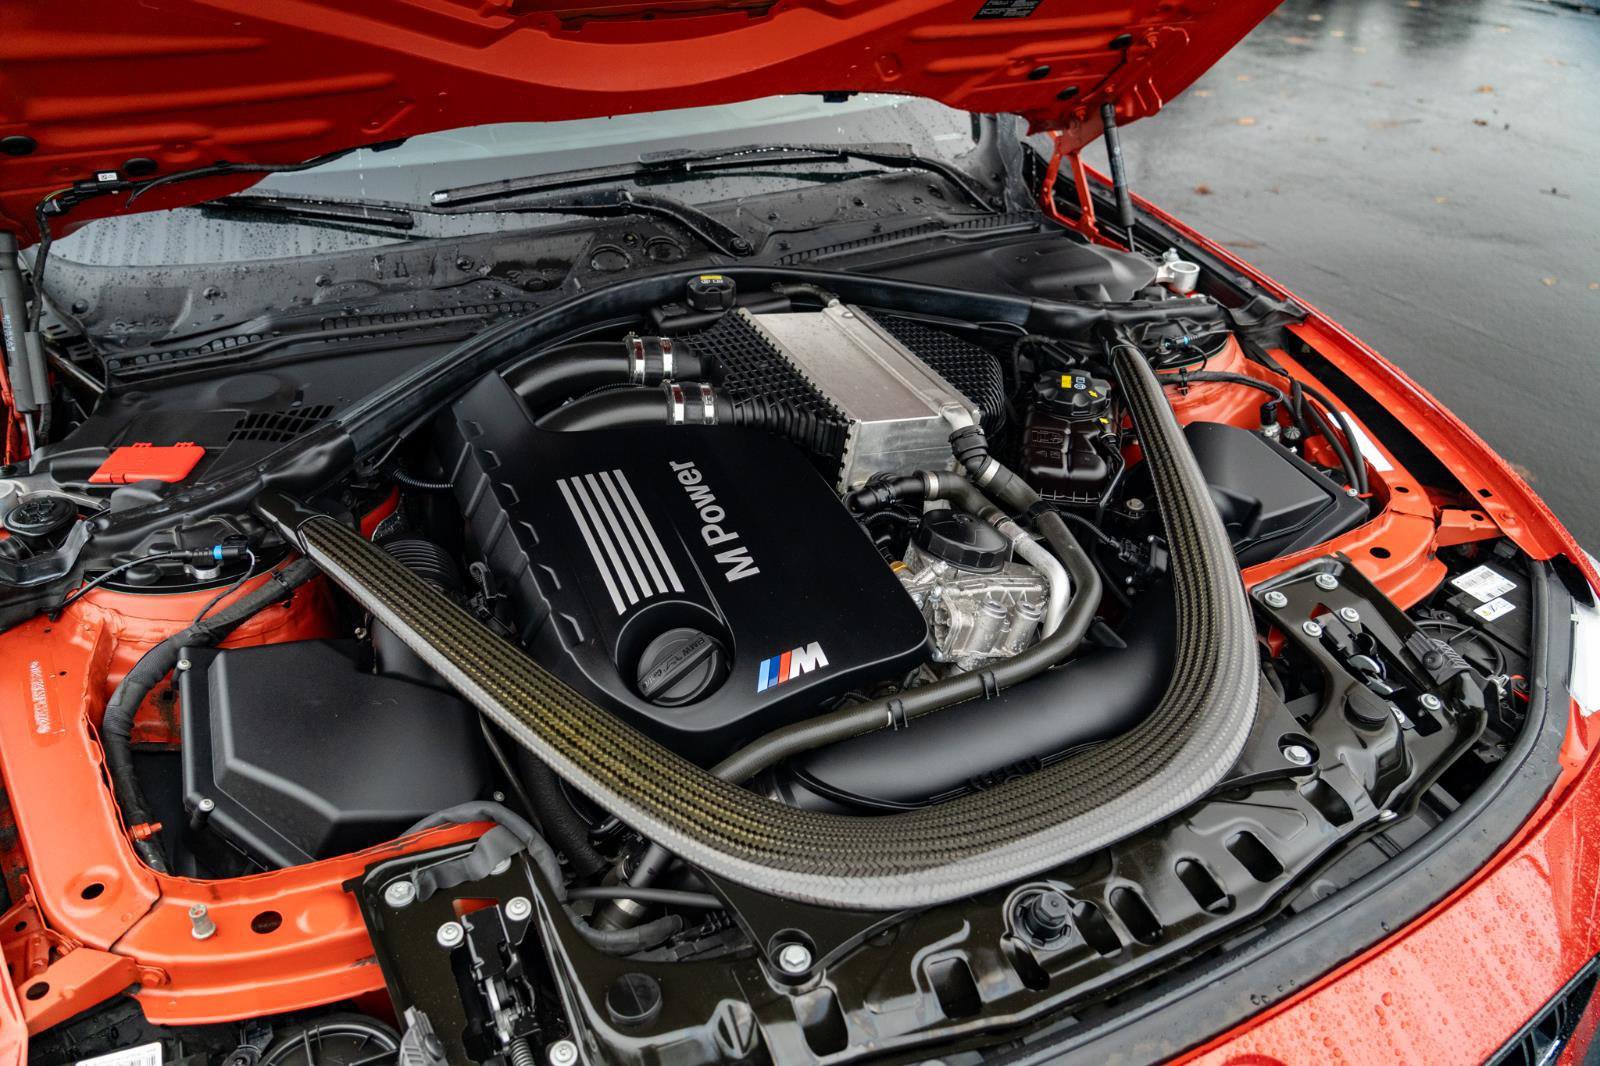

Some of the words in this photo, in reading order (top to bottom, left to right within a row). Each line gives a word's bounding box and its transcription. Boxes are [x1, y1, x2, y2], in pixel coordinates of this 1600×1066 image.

[669, 460, 740, 546] Power
[714, 546, 760, 582] M
[789, 641, 829, 680] M
